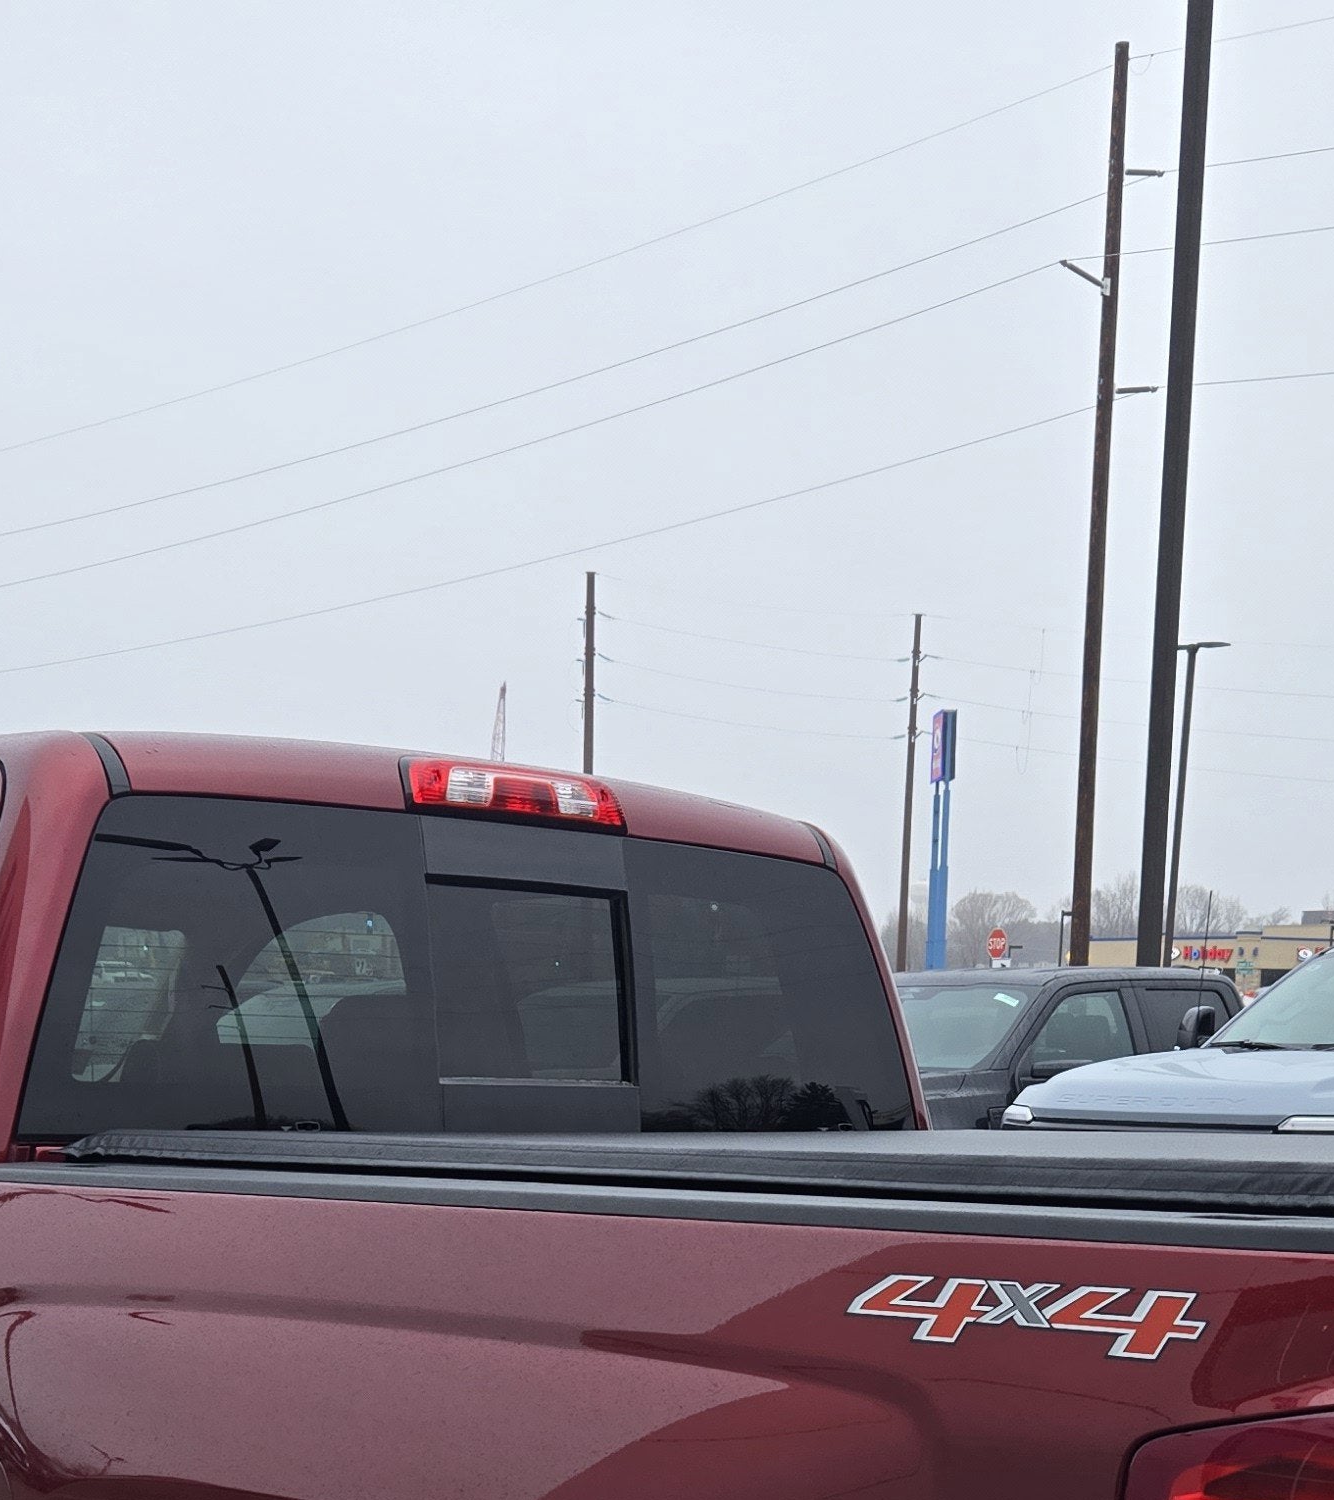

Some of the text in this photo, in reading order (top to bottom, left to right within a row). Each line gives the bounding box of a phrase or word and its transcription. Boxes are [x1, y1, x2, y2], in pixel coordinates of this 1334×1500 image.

[988, 937, 1006, 950] STOP
[1182, 946, 1234, 964] Holiday
[1056, 1092, 1152, 1106] SUPER
